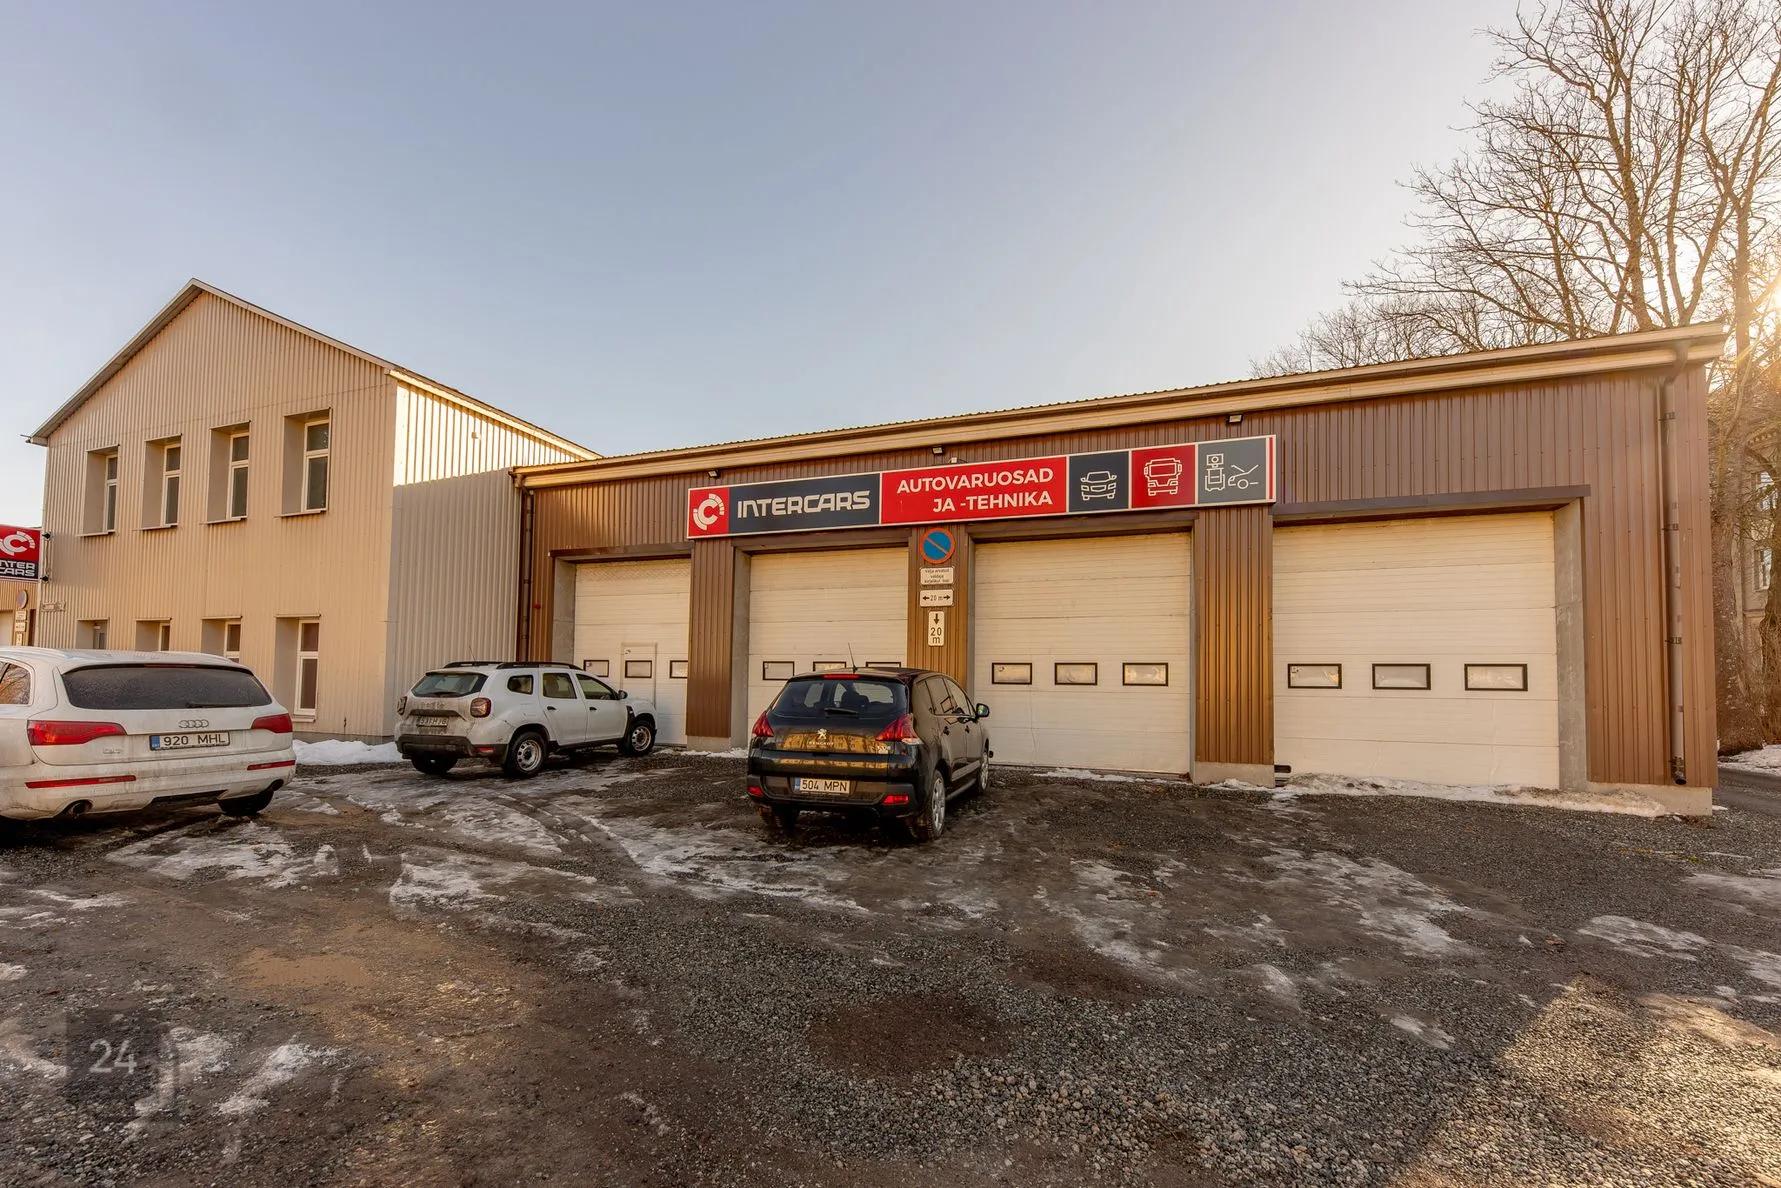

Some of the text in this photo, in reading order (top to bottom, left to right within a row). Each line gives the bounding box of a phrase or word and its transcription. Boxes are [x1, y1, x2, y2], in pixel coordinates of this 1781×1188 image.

[896, 467, 1054, 495] AUTOVARUOSAD
[737, 490, 871, 519] INTERCARS
[932, 490, 1053, 513] JA -TEHNIKA
[930, 594, 937, 602] 20
[930, 626, 942, 637] 20
[932, 636, 941, 644] m
[163, 735, 189, 747] 920
[197, 733, 226, 745] MHL
[802, 779, 847, 792] 504 MPN
